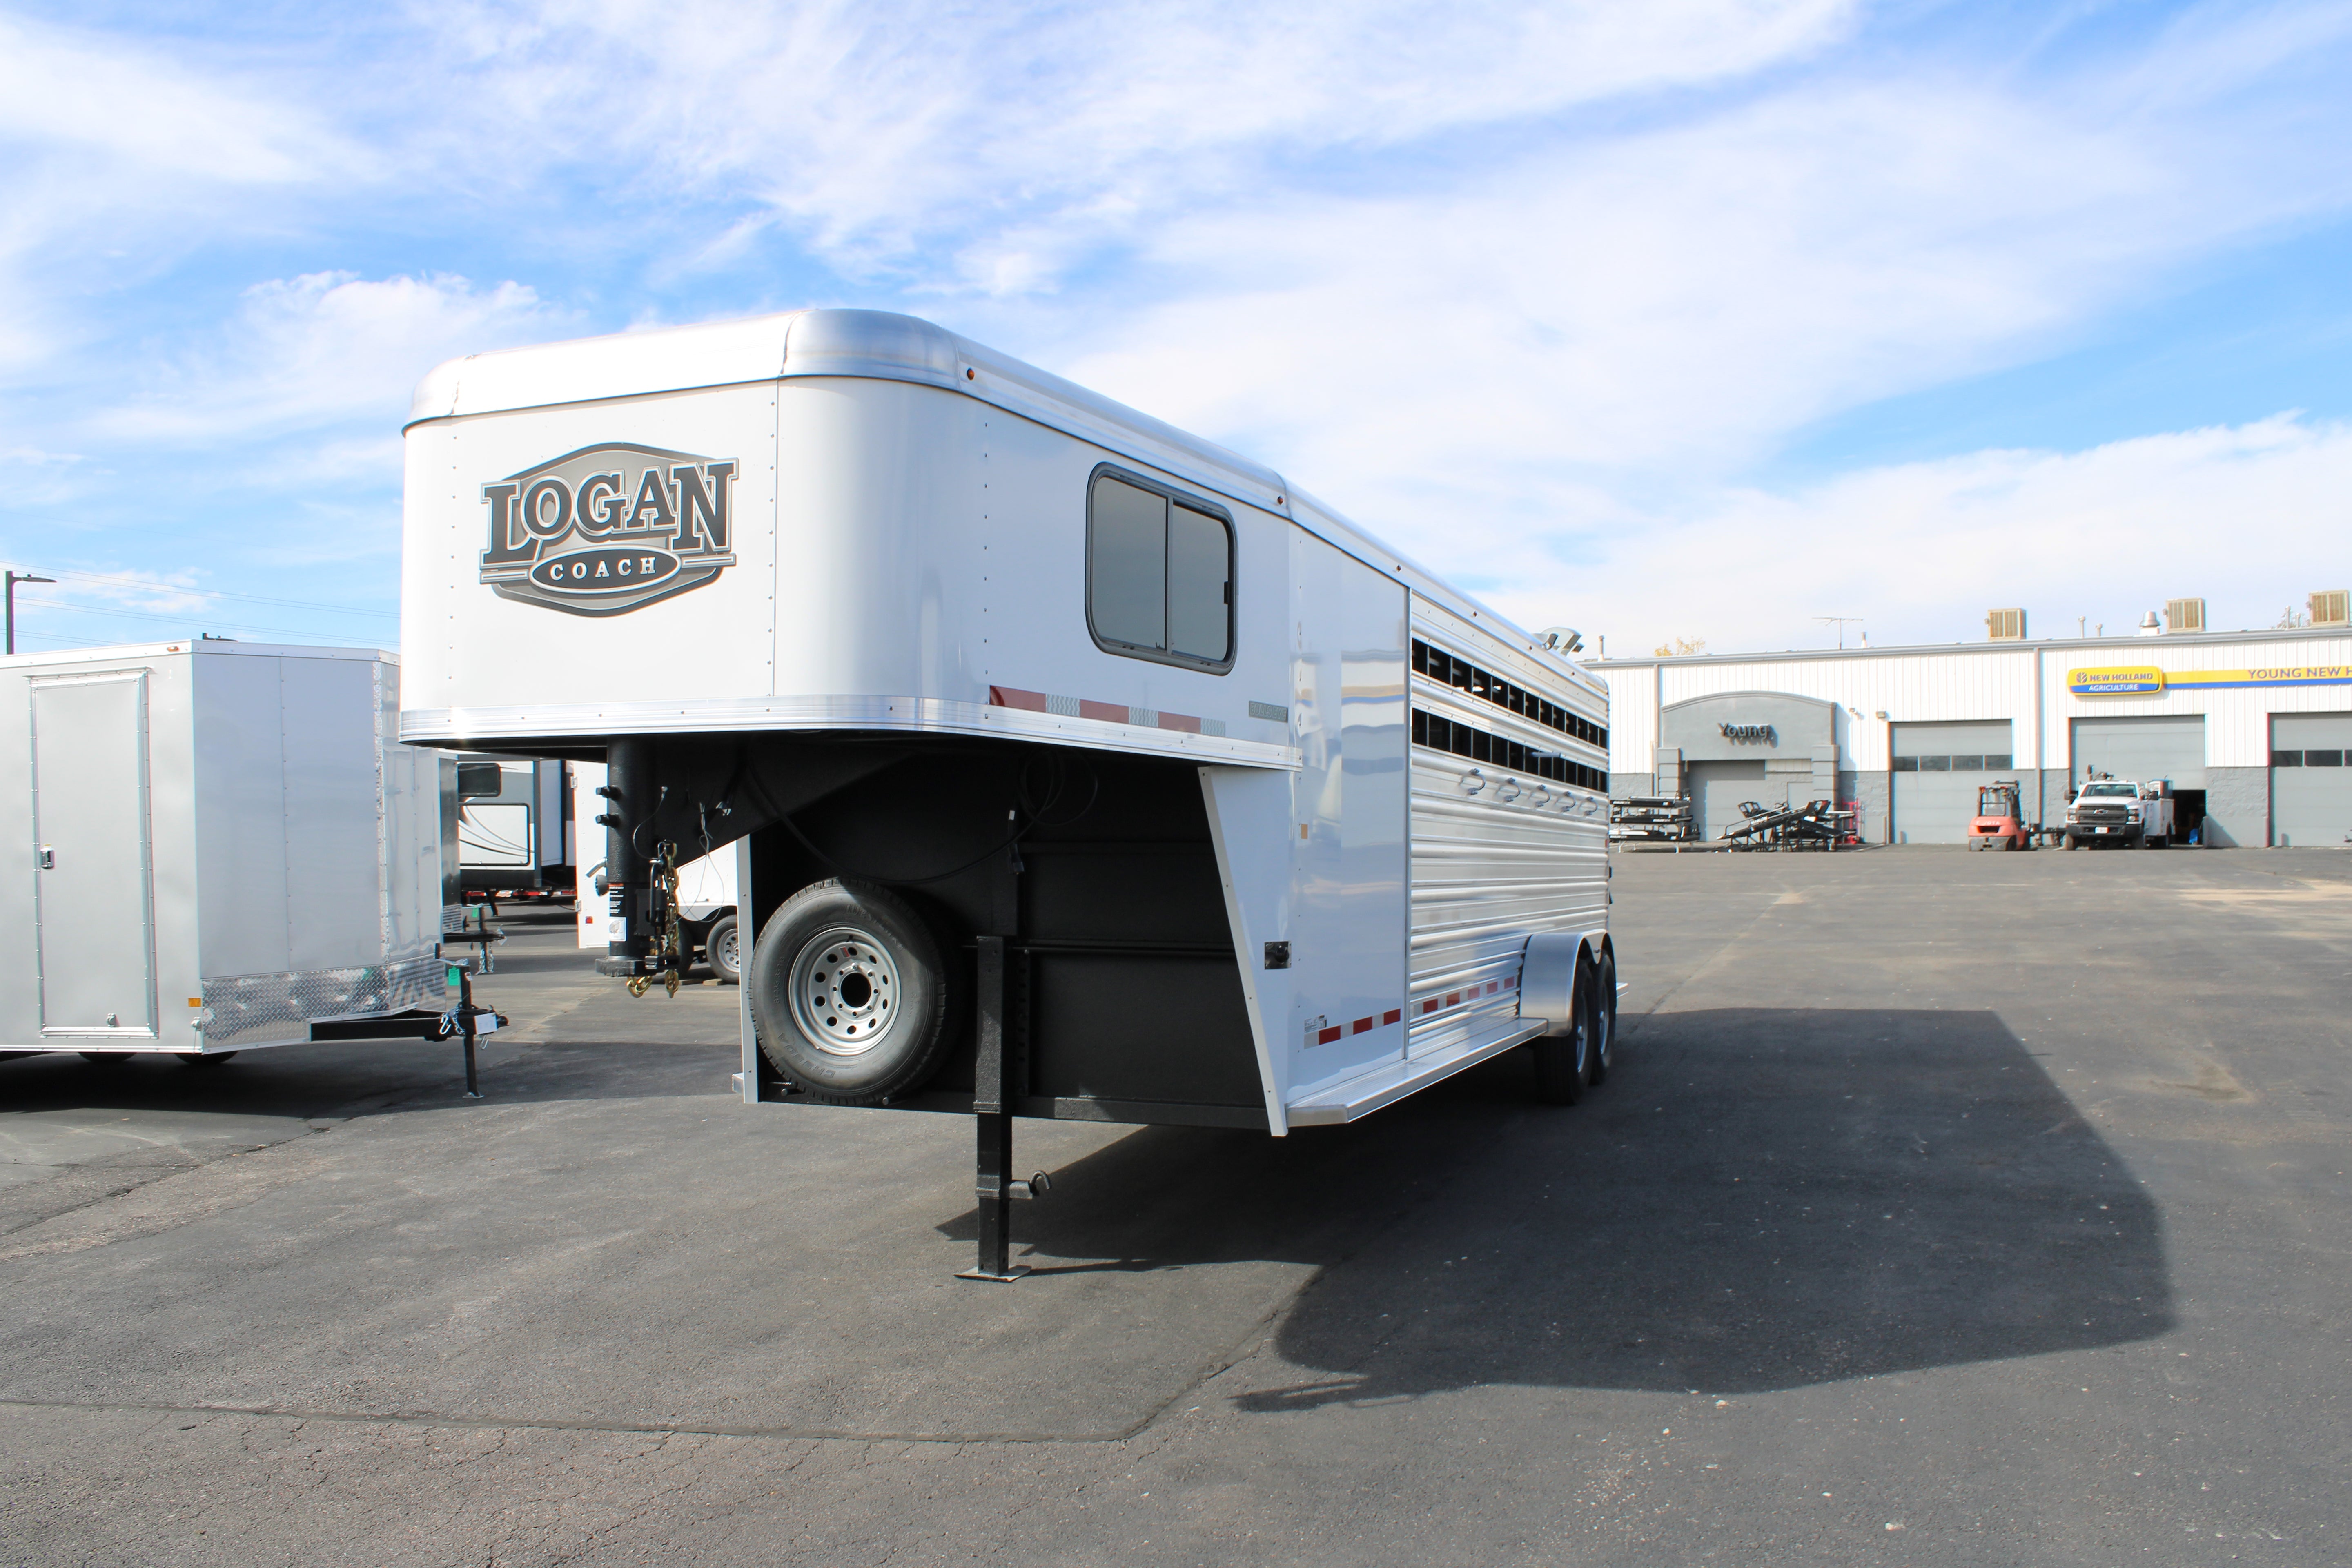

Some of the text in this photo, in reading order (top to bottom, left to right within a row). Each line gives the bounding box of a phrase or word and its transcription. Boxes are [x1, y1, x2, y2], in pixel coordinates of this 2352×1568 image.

[480, 457, 739, 570] LOGAN
[550, 557, 656, 581] COACH
[2248, 668, 2302, 679] YOUNG
[2307, 667, 2341, 677] NEW
[2088, 684, 2138, 692] AGRICULTURE
[1250, 702, 1287, 720] BULLSEYE
[1717, 722, 1769, 740] Young
